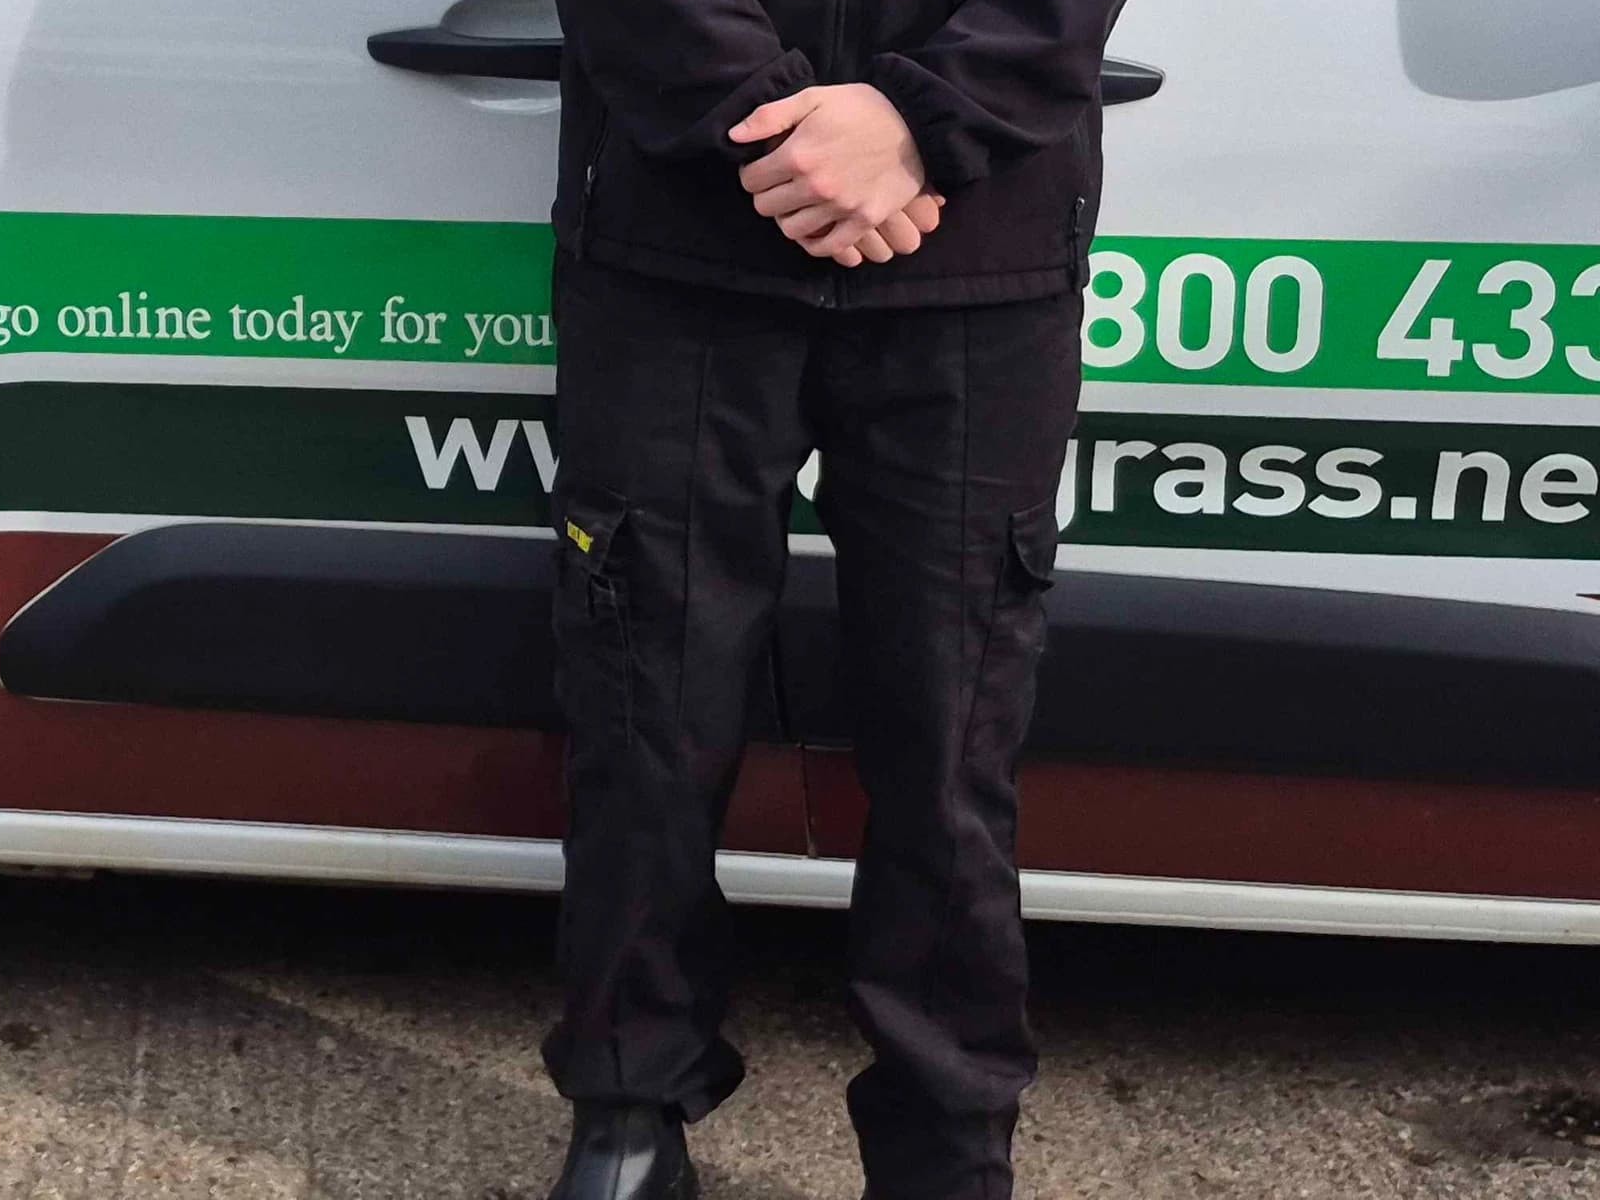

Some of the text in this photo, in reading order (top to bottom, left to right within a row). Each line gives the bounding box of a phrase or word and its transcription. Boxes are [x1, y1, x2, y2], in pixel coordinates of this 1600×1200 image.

[57, 293, 212, 338] online
[228, 296, 362, 352] today
[378, 297, 446, 345] for
[464, 312, 553, 357] you
